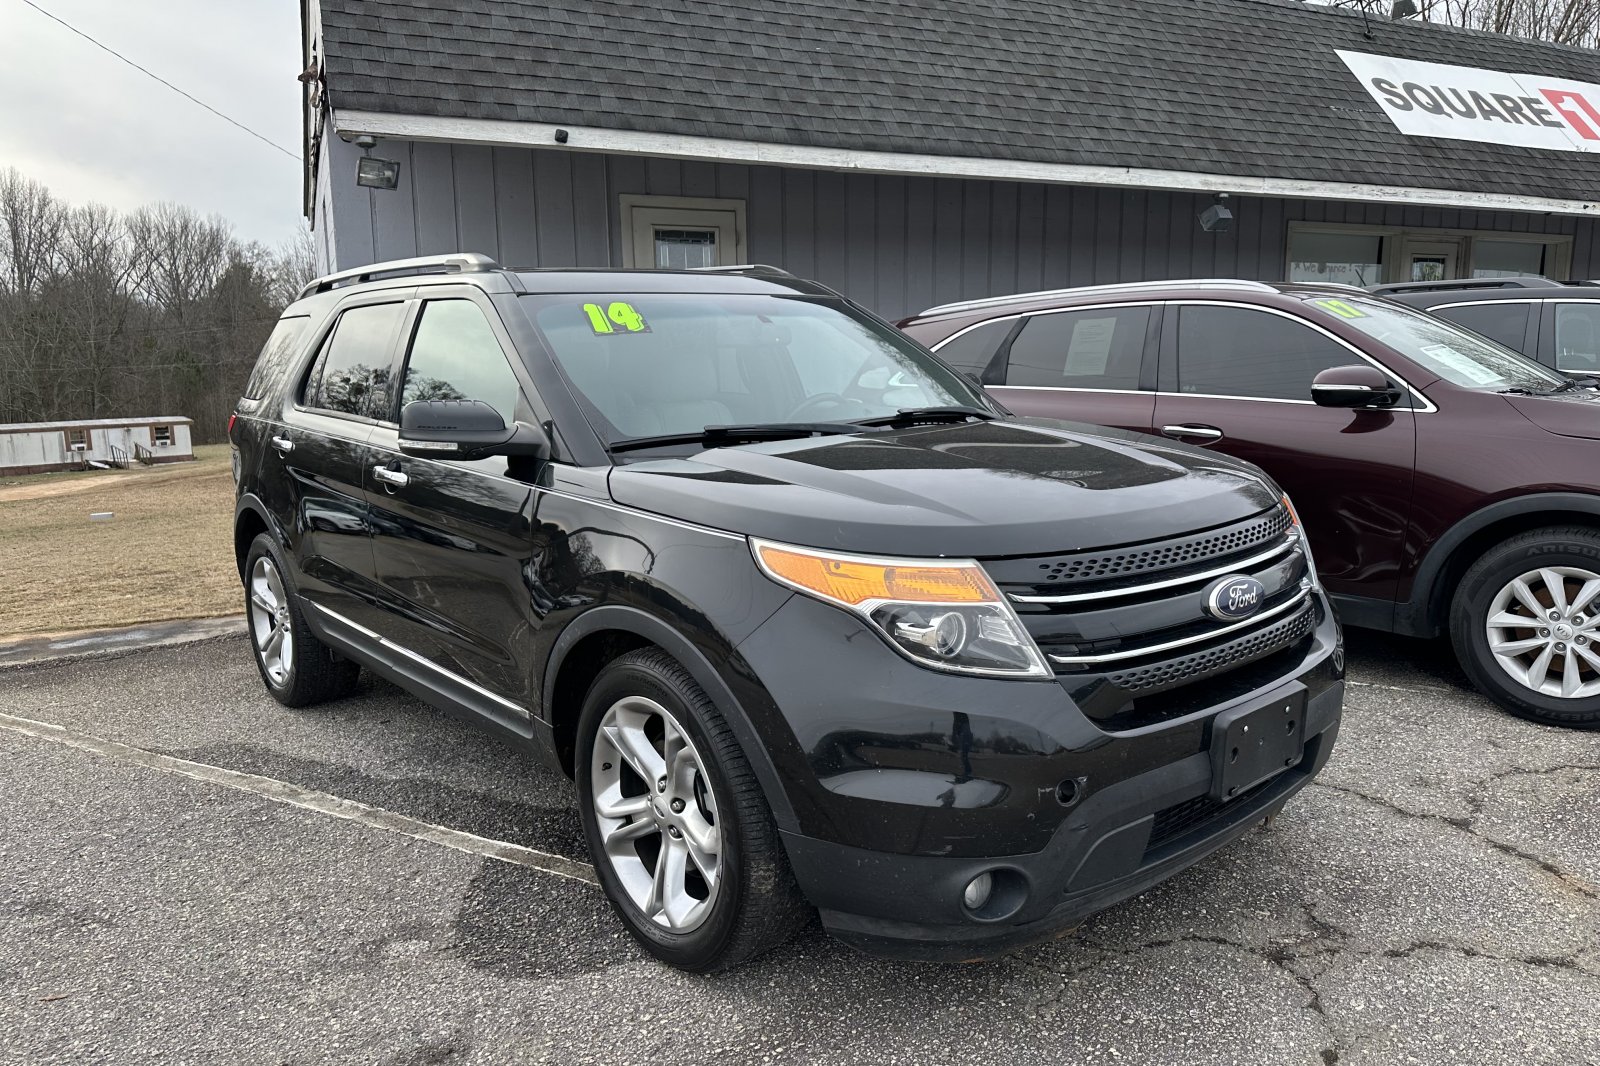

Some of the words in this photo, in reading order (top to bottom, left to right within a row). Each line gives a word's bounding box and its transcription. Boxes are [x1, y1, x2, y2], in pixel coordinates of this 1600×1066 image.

[1371, 78, 1566, 129] SQUARE
[583, 302, 645, 333] 14
[1314, 300, 1367, 318] 17
[1528, 545, 1600, 558] ARISU
[1229, 583, 1257, 611] Ford
